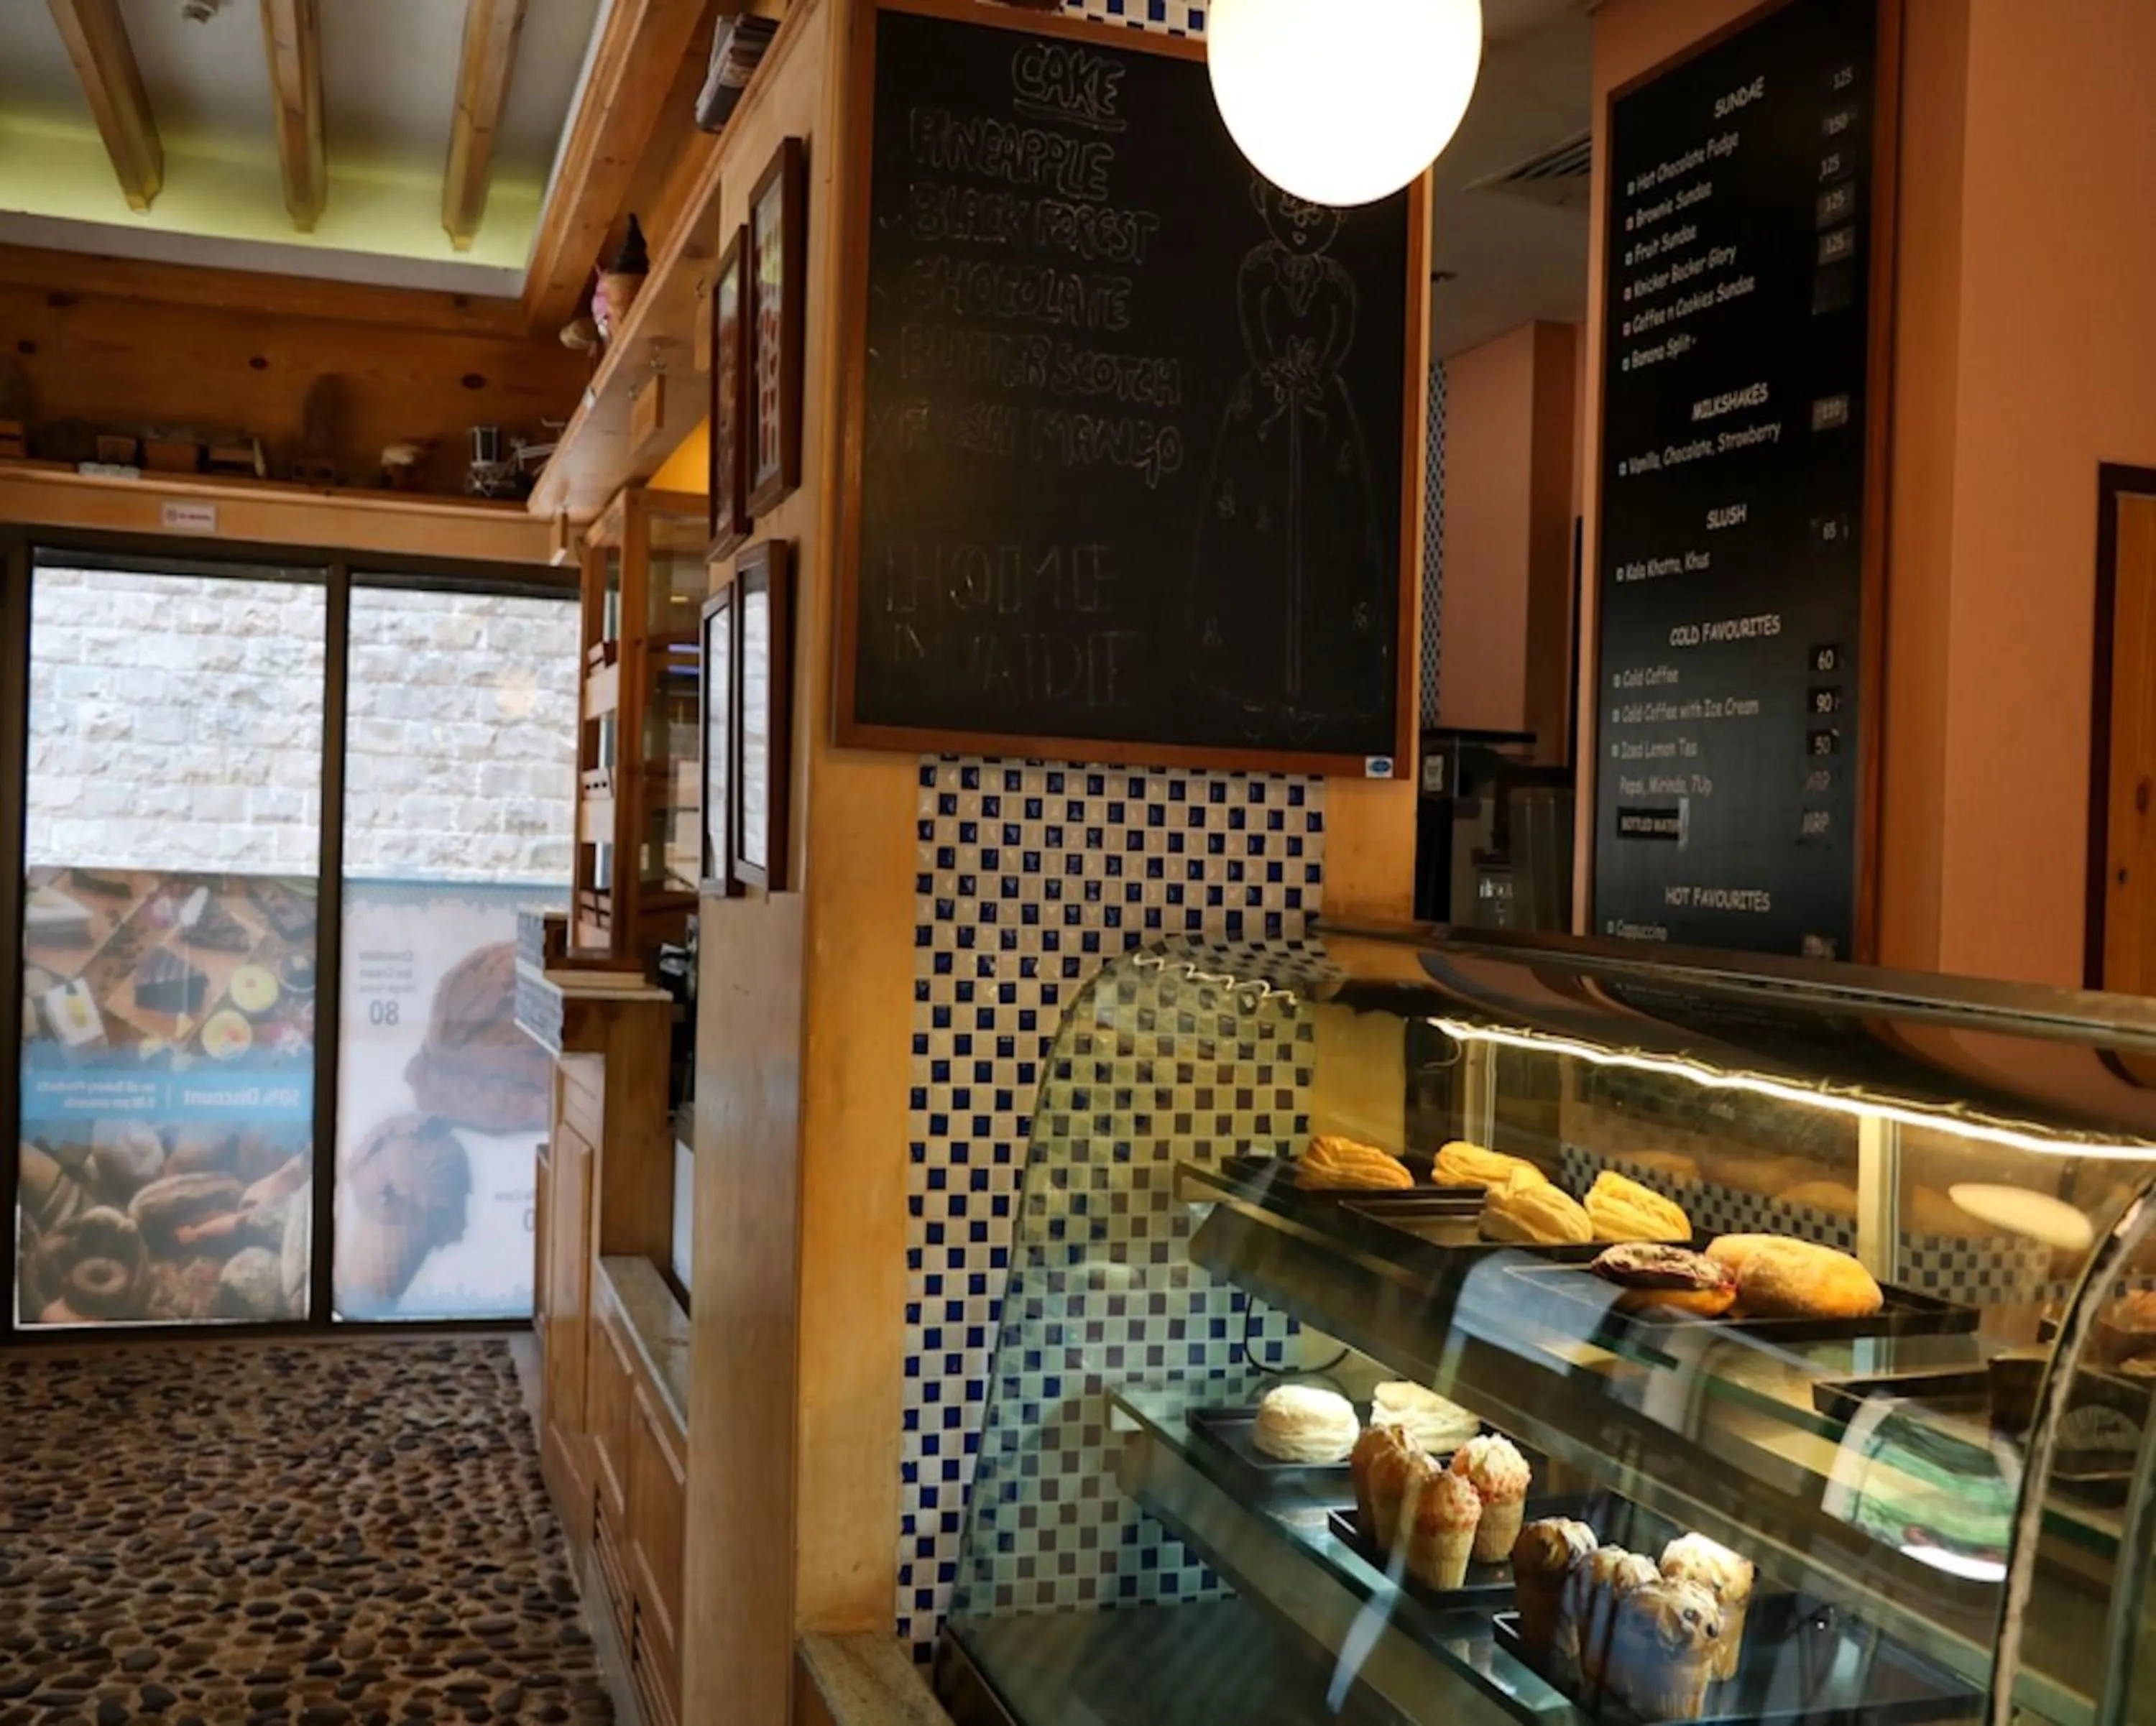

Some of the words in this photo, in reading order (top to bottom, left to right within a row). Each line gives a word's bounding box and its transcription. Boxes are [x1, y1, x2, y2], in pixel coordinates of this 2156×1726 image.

[1012, 40, 1127, 117] CAKE
[1713, 74, 1766, 120] SUNDAE
[909, 108, 1115, 202] PINEAPPLE
[1657, 148, 1705, 185] Chocolate
[1706, 131, 1740, 160] Fudge
[908, 181, 1031, 246] BLACK
[1036, 197, 1161, 267] FOREST
[1636, 197, 1674, 229] Brownie
[1634, 238, 1660, 264] Fruit
[1708, 244, 1738, 271] Glory
[906, 254, 1133, 331] CHOCOLATE
[1632, 308, 1666, 335] Coffee
[1675, 289, 1715, 319] Cookies
[1631, 343, 1666, 371] Banana
[1690, 380, 1771, 423] MILKSHAKES
[898, 398, 1019, 457] FESH
[1717, 420, 1782, 454] Strawberry
[1705, 502, 1749, 532] SLUSH
[1669, 623, 1700, 647] COLD
[1701, 613, 1782, 645] FAVOURITES
[1816, 648, 1835, 671] 60
[1623, 668, 1644, 688] Cold
[1645, 665, 1680, 686] Coffee
[1621, 703, 1643, 724] Cold
[1644, 701, 1678, 721] Coffee
[1679, 699, 1703, 719] with
[1703, 698, 1723, 718] Ice
[1724, 696, 1760, 717] Cream
[1815, 691, 1833, 714] 90
[1621, 740, 1644, 760] Iced
[1644, 739, 1677, 760] Lemon
[1677, 737, 1698, 757] Tea
[1814, 734, 1832, 755] 50
[1664, 886, 1690, 906] HOT
[1692, 886, 1771, 913] FAVOURITES
